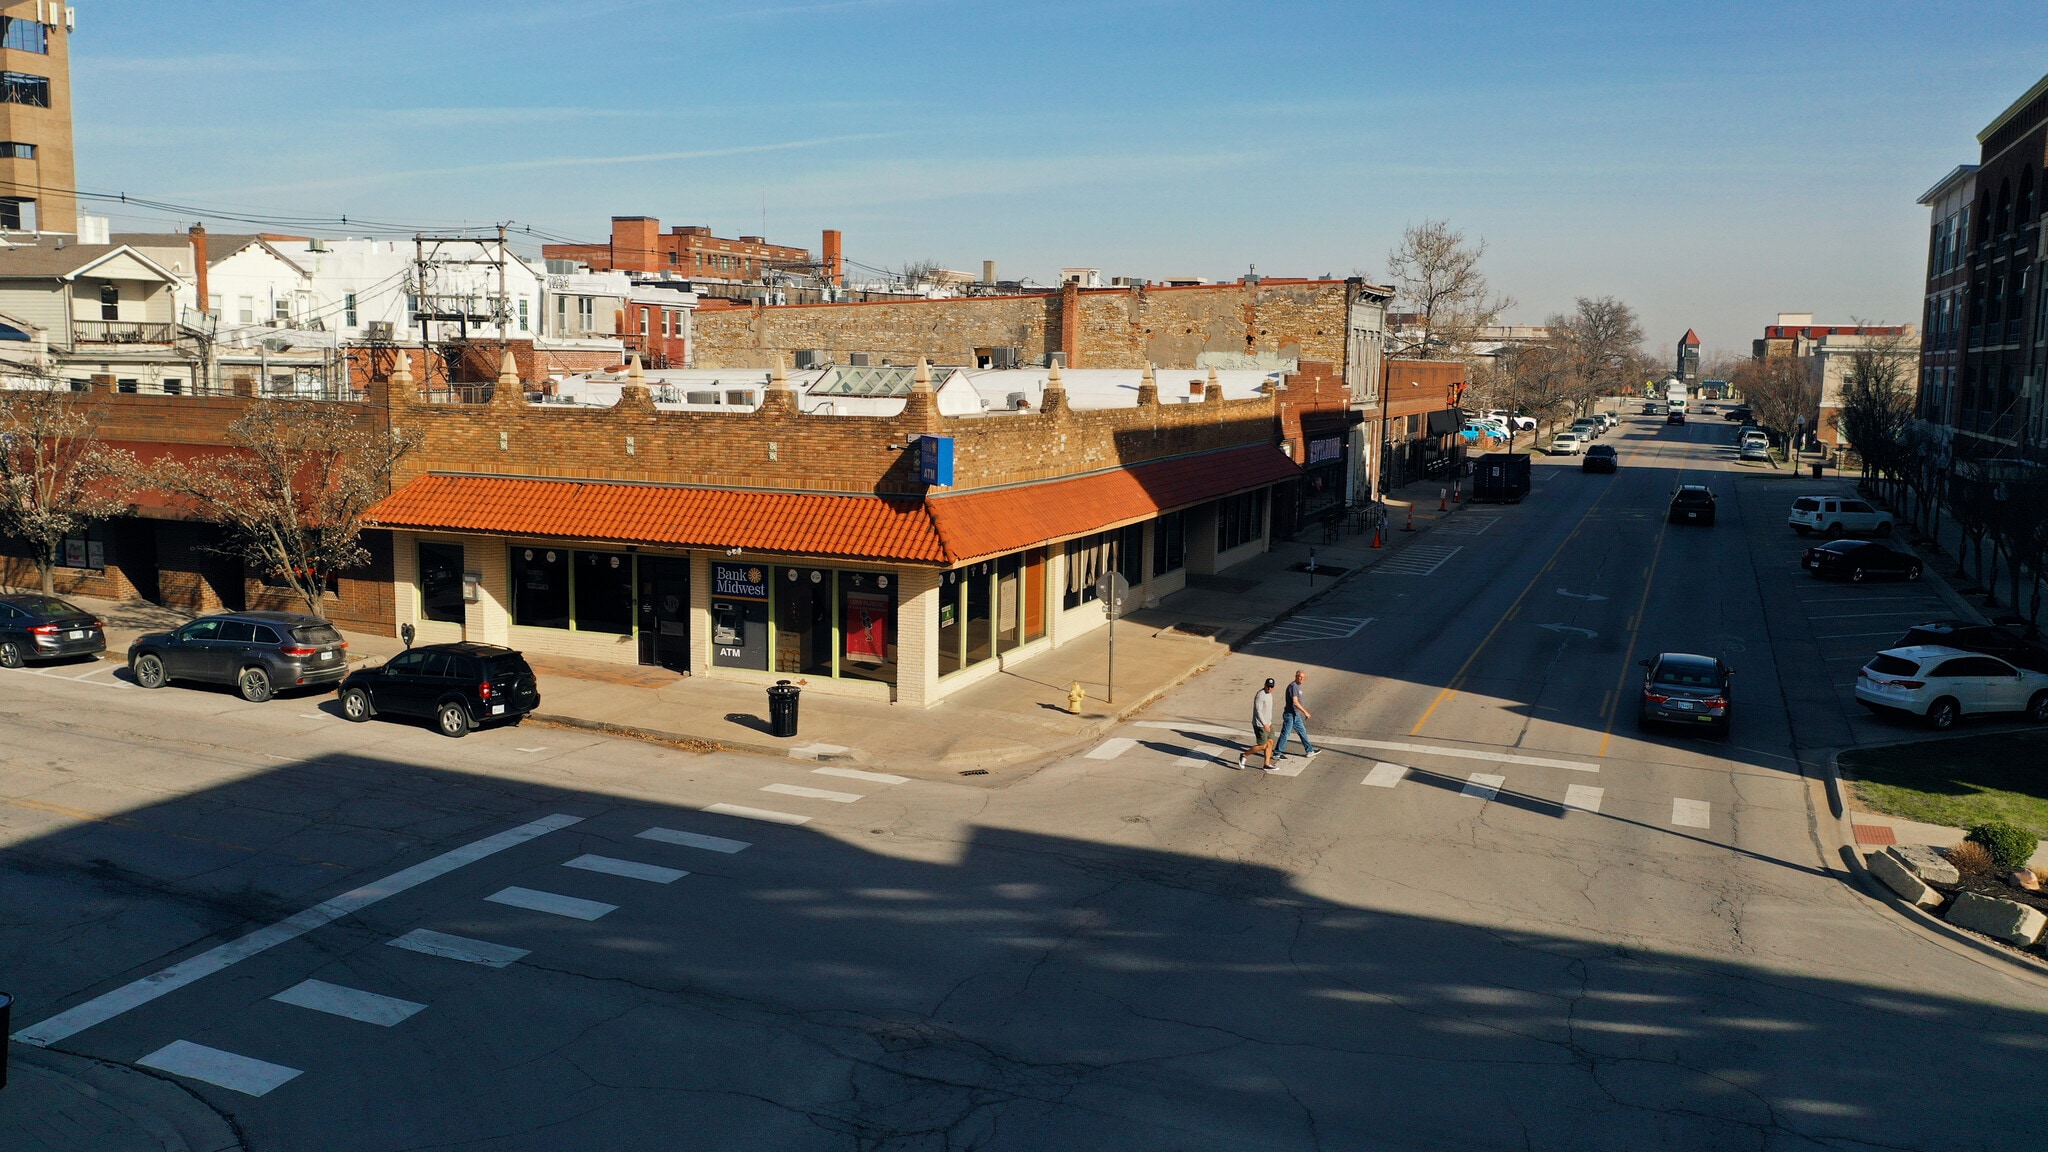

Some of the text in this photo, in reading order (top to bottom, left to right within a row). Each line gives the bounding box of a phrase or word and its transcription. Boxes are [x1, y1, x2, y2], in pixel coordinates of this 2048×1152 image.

[923, 468, 935, 480] ATM
[717, 566, 747, 582] Bank
[717, 580, 765, 596] Midwest
[719, 647, 741, 657] ATM
